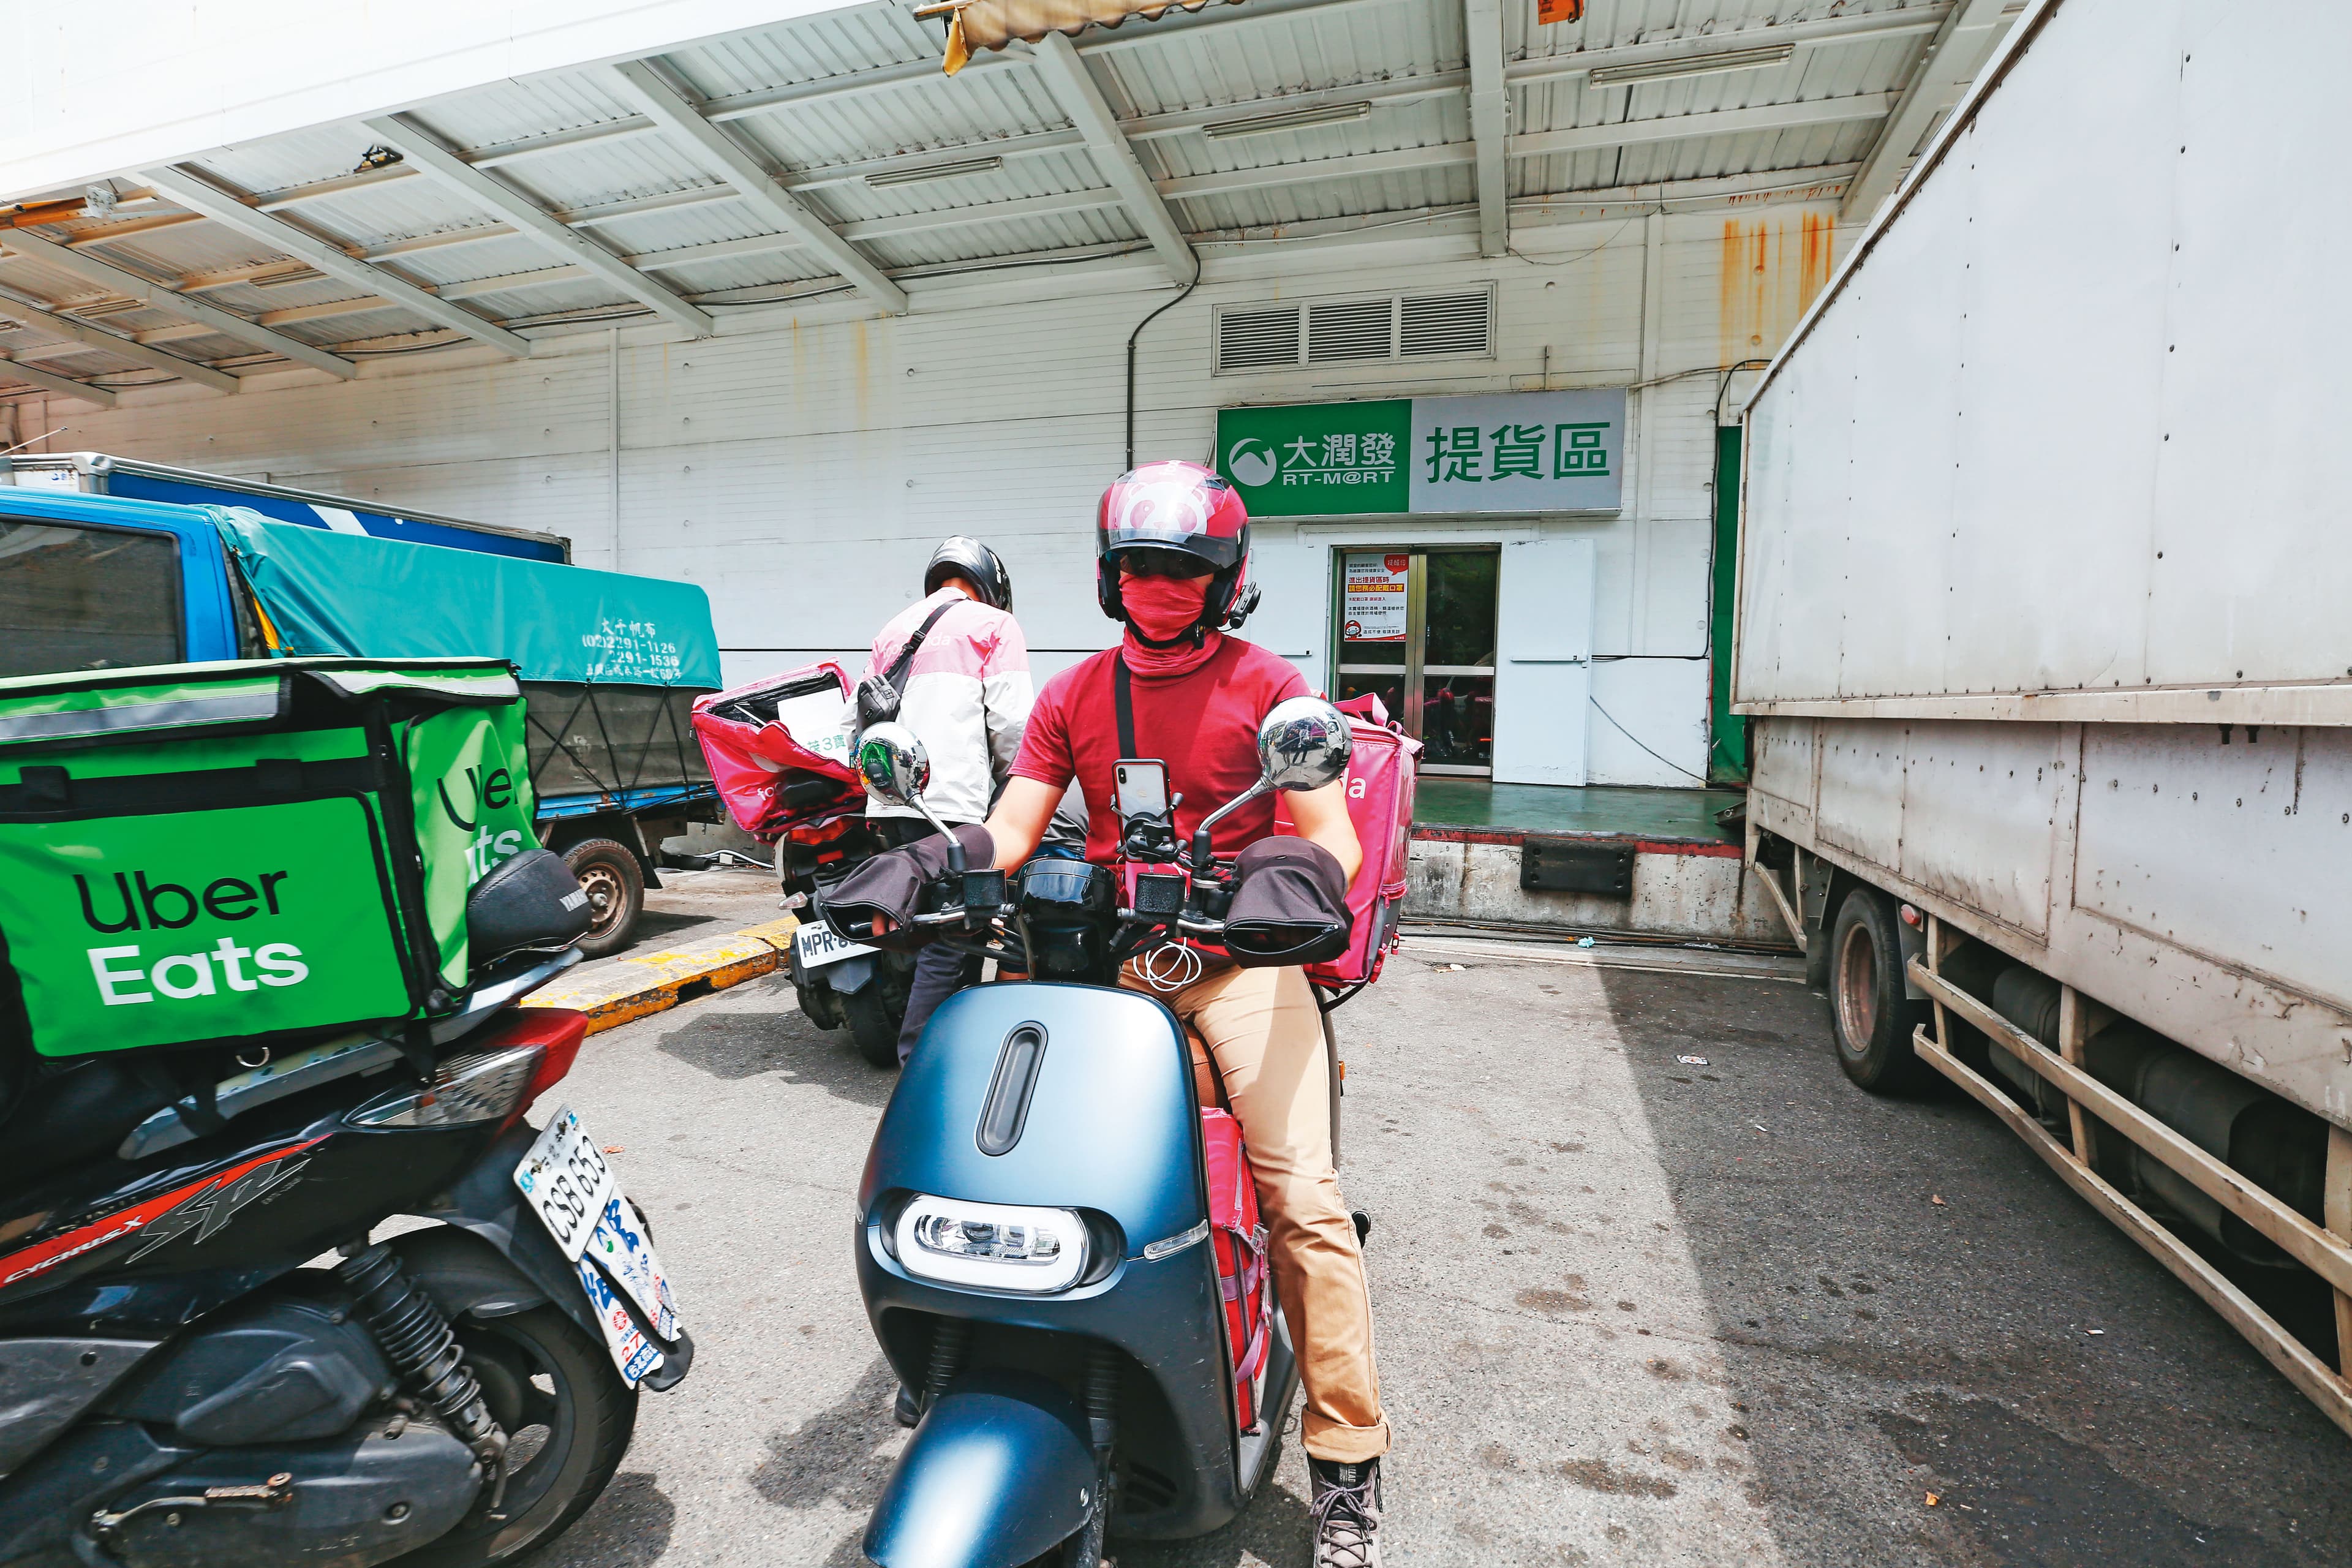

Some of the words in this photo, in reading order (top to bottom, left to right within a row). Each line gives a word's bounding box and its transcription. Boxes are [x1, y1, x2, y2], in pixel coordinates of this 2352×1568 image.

[1283, 432, 1396, 468] 大潤發
[1283, 470, 1395, 486] RT-M@RT
[1425, 421, 1611, 483] 提貨區
[437, 764, 519, 832] Ue
[73, 870, 288, 934] Uber
[87, 937, 309, 1006] Eats
